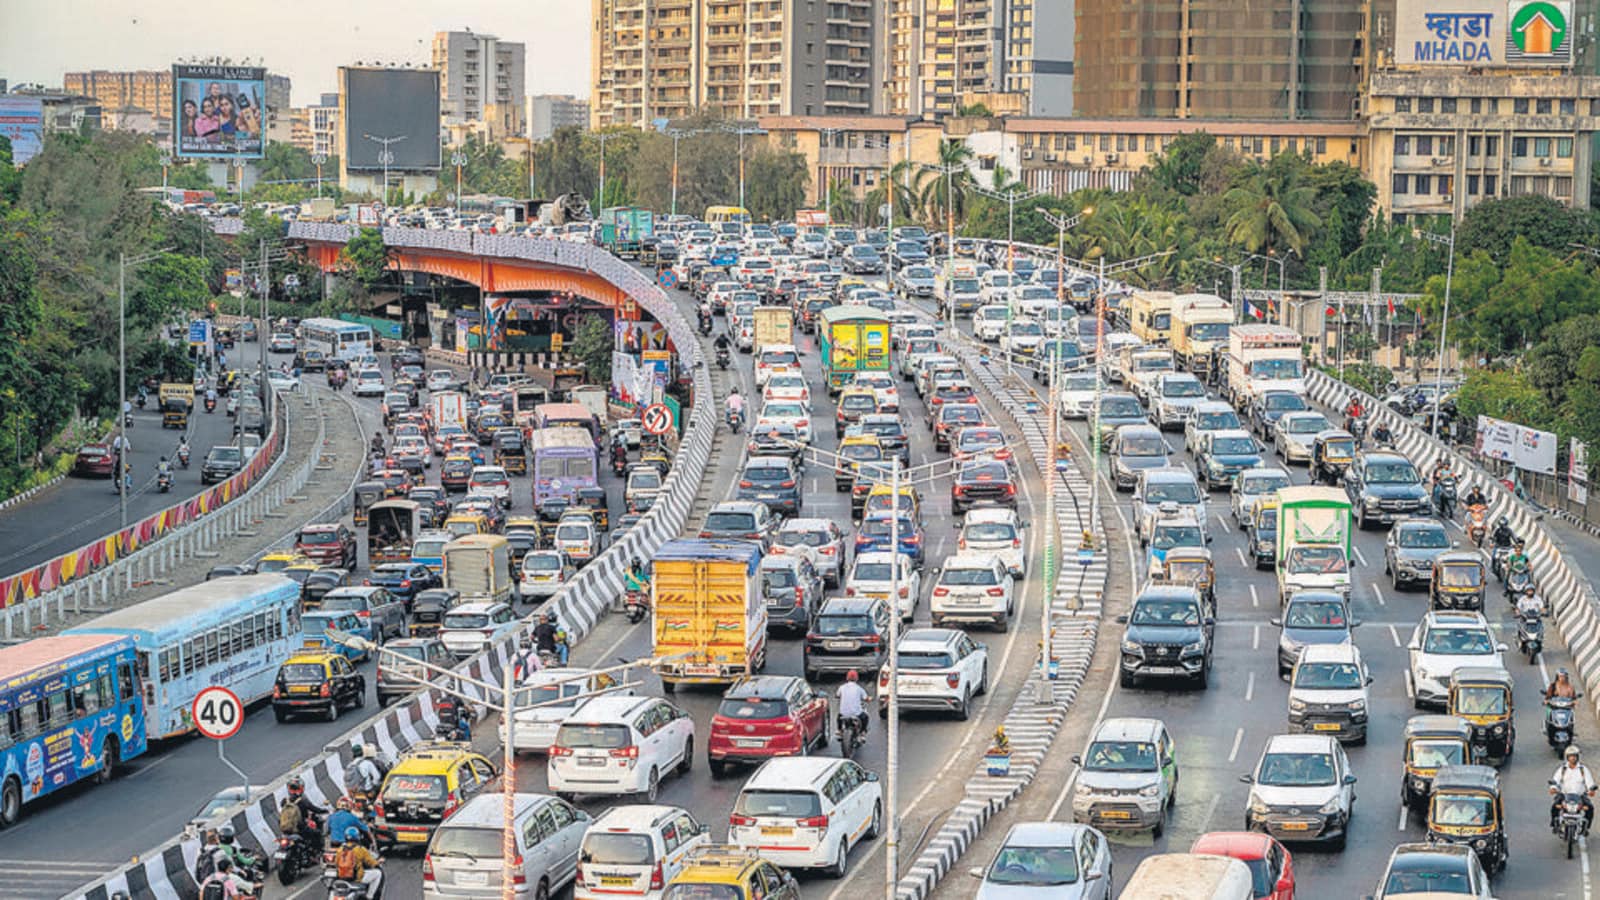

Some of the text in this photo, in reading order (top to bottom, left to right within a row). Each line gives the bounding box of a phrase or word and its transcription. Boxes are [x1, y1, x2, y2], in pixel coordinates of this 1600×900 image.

[1425, 13, 1493, 40] म्हाडा
[1415, 41, 1492, 61] MHADA
[188, 67, 254, 76] MAYBELLINE
[201, 699, 235, 725] 40
